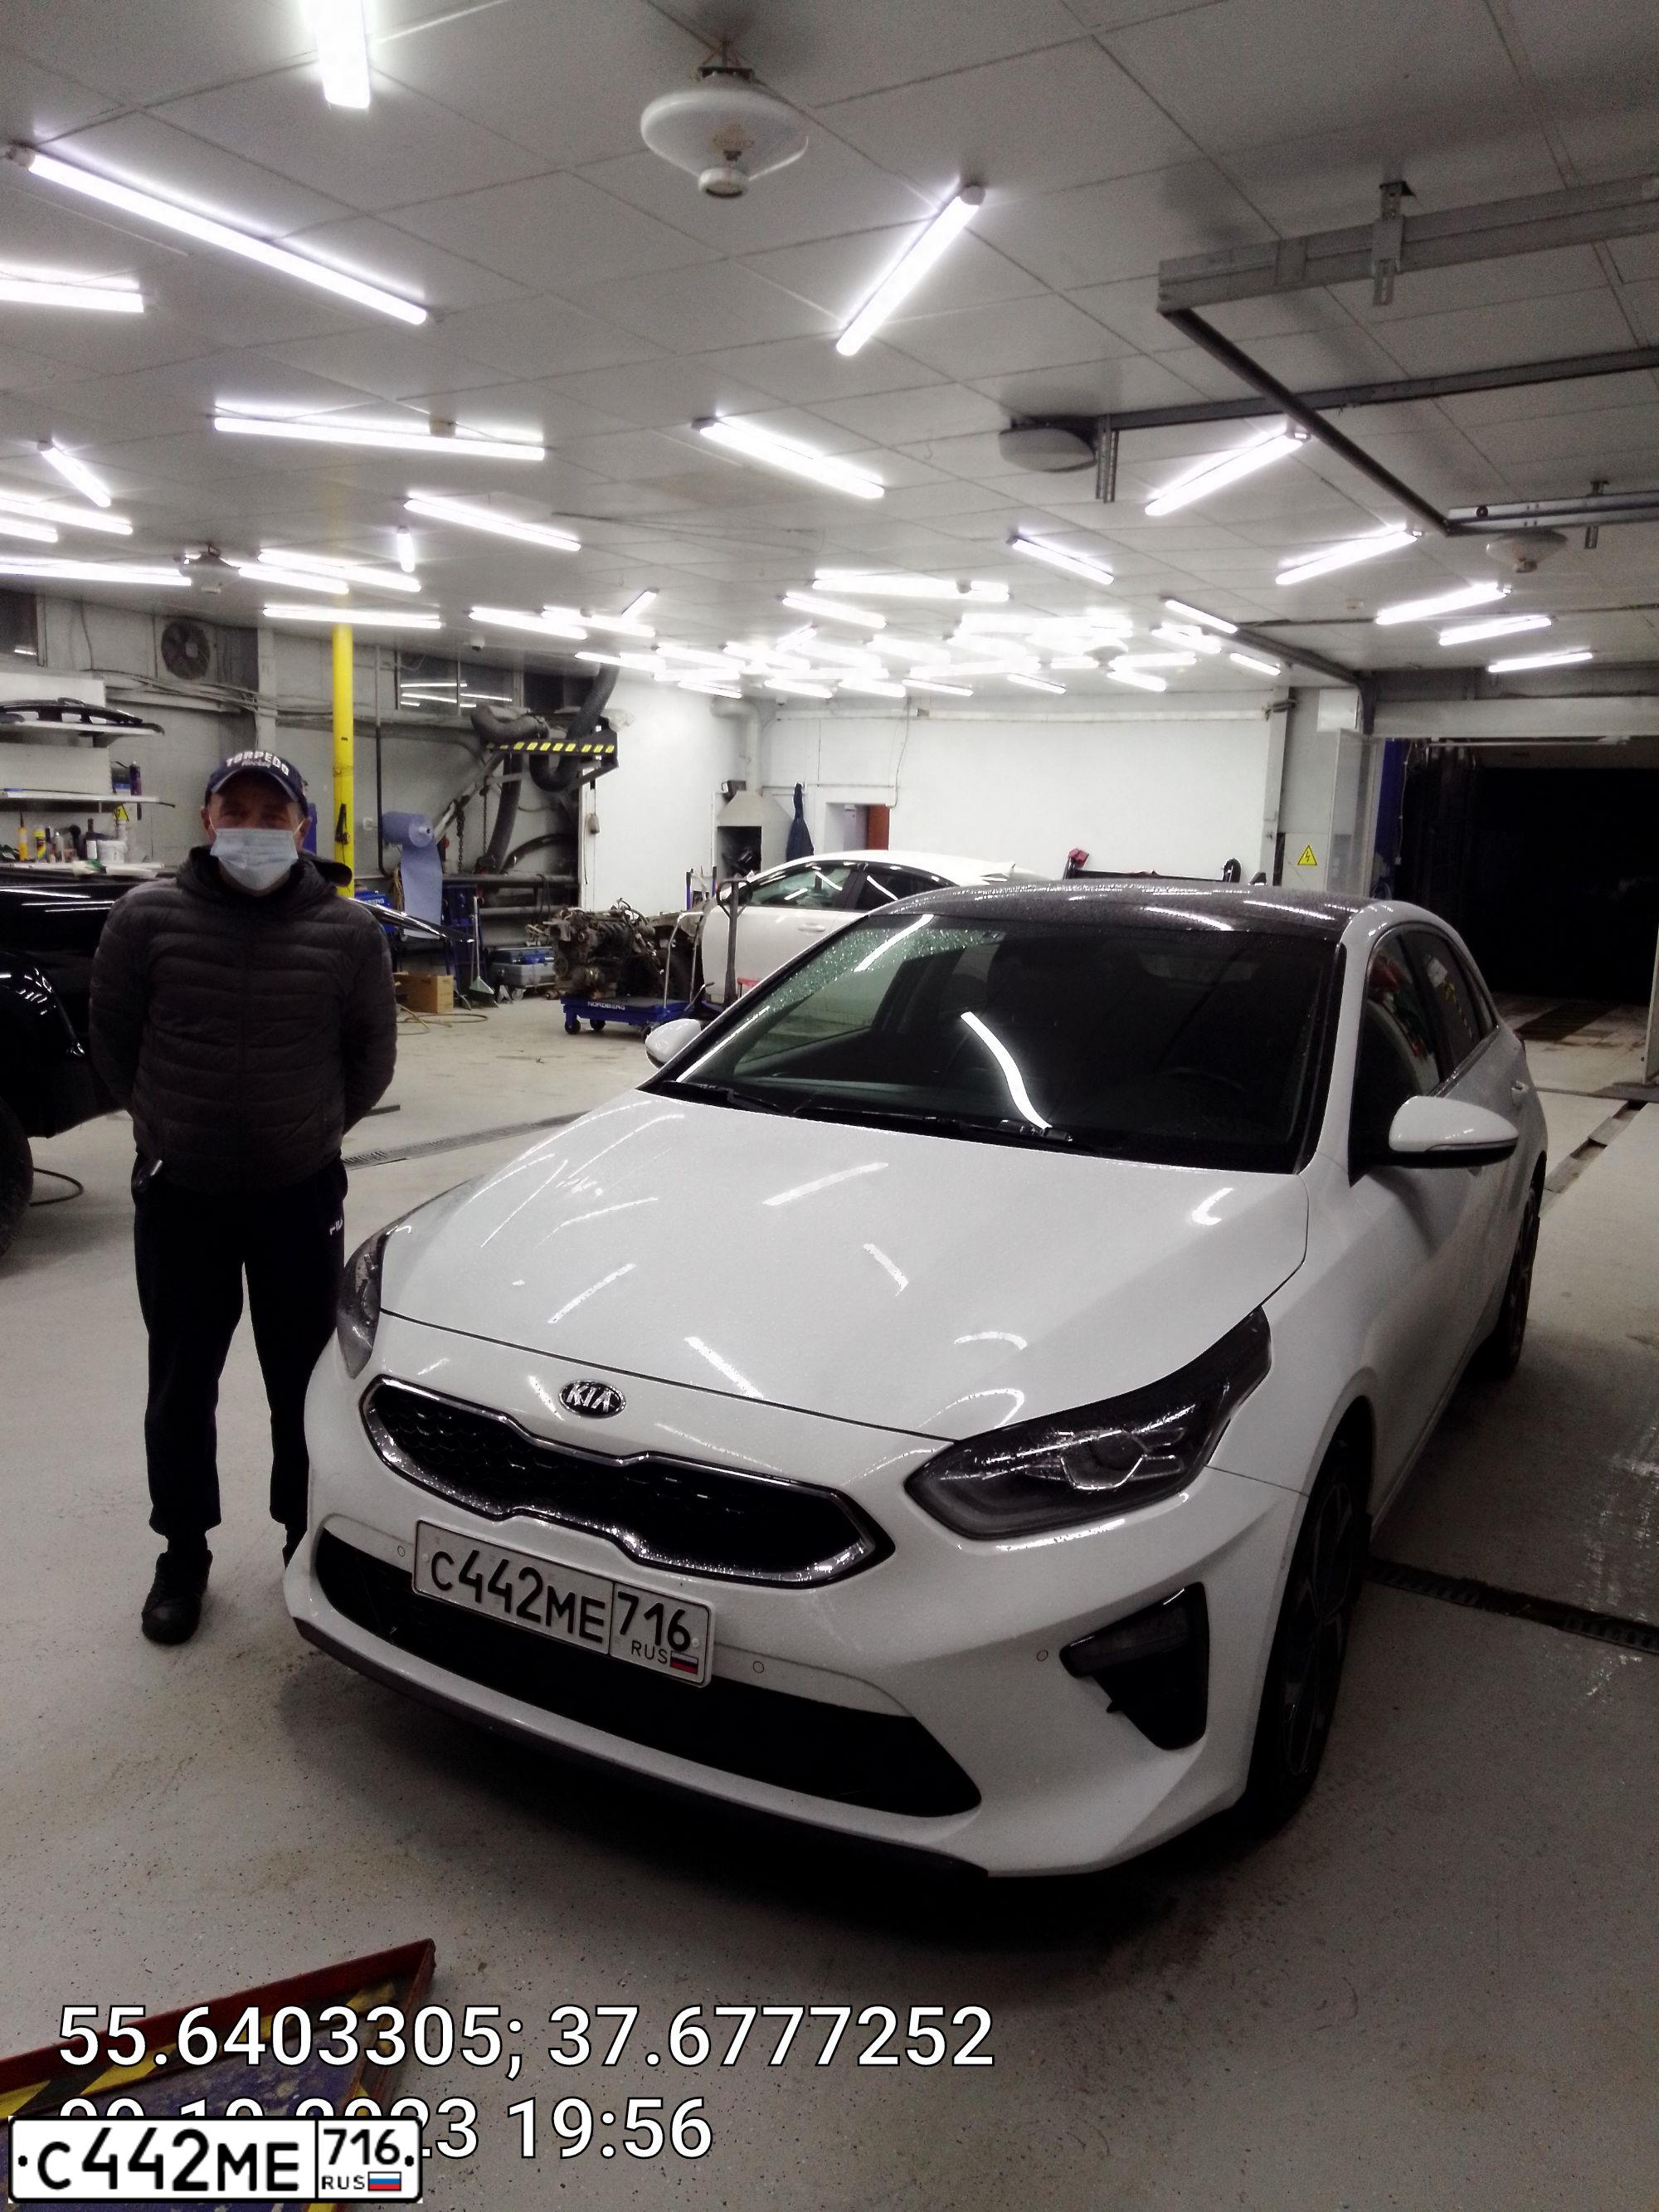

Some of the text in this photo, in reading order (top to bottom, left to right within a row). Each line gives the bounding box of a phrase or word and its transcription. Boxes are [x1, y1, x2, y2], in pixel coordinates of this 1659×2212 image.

[226, 751, 289, 777] TORPEDO
[566, 1383, 614, 1413] KIA
[617, 1591, 692, 1652] 716
[630, 1640, 669, 1664] RUS
